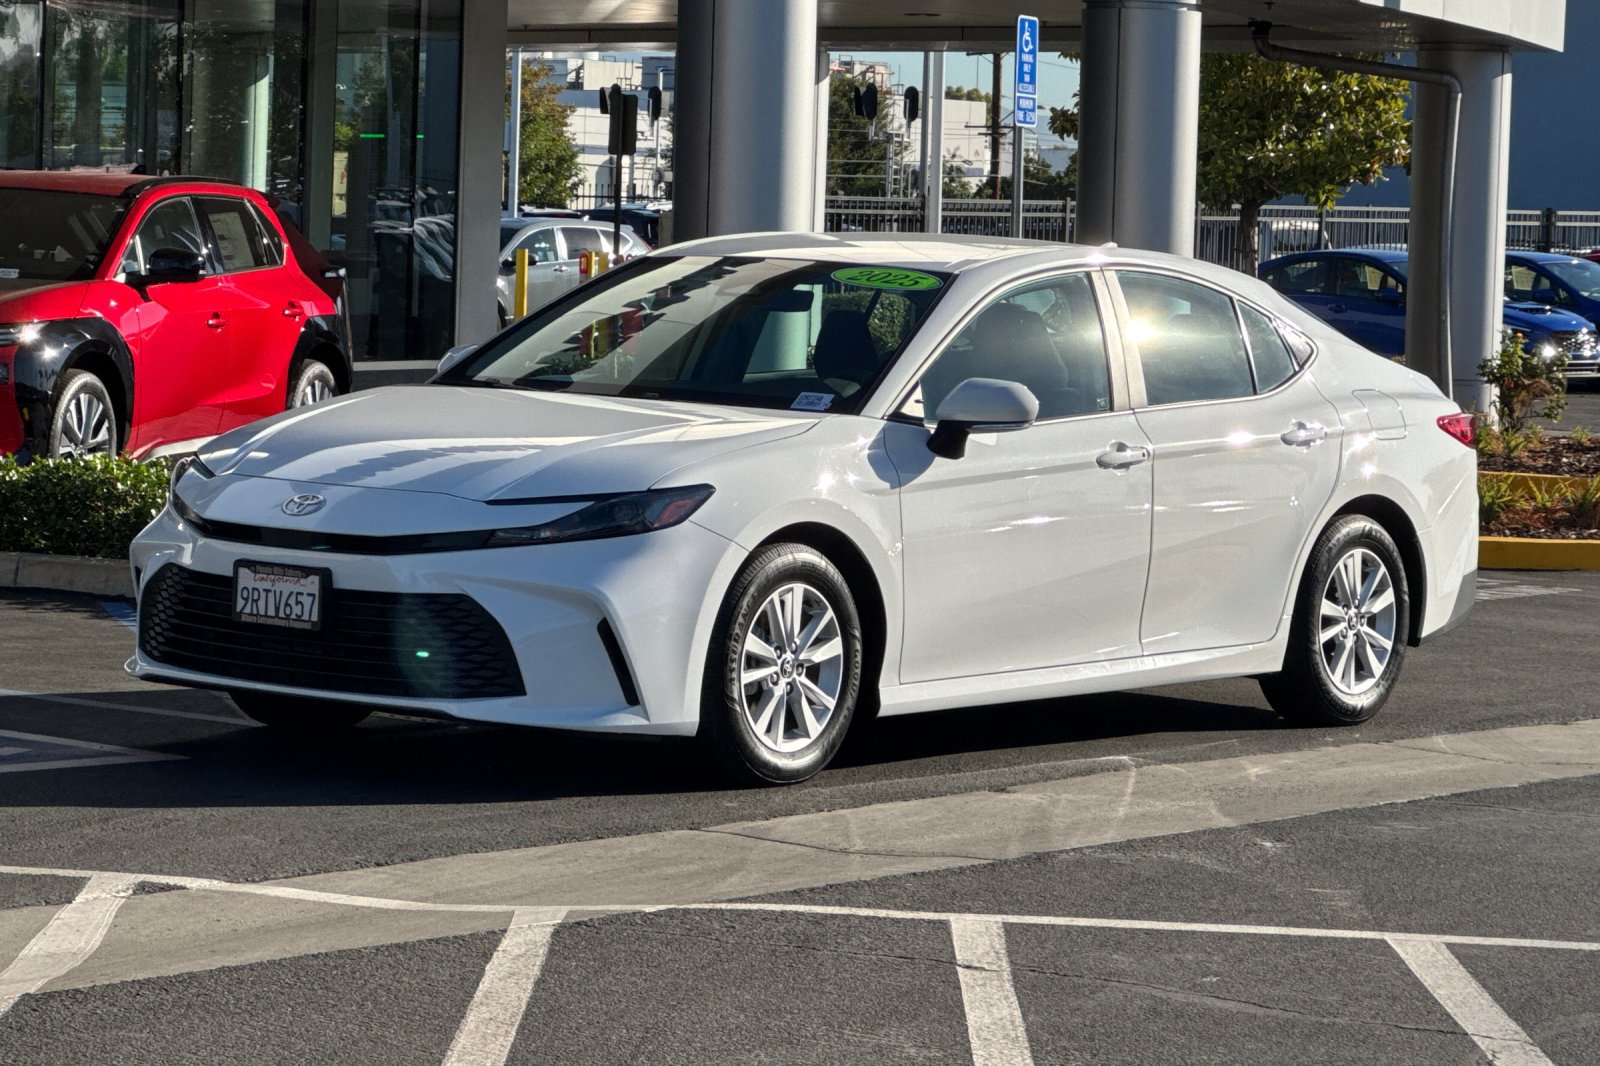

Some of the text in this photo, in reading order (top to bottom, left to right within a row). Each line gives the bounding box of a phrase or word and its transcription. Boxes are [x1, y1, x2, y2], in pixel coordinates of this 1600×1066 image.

[846, 270, 930, 287] 2025
[253, 573, 307, 587] California
[240, 586, 316, 621] 9RTV657
